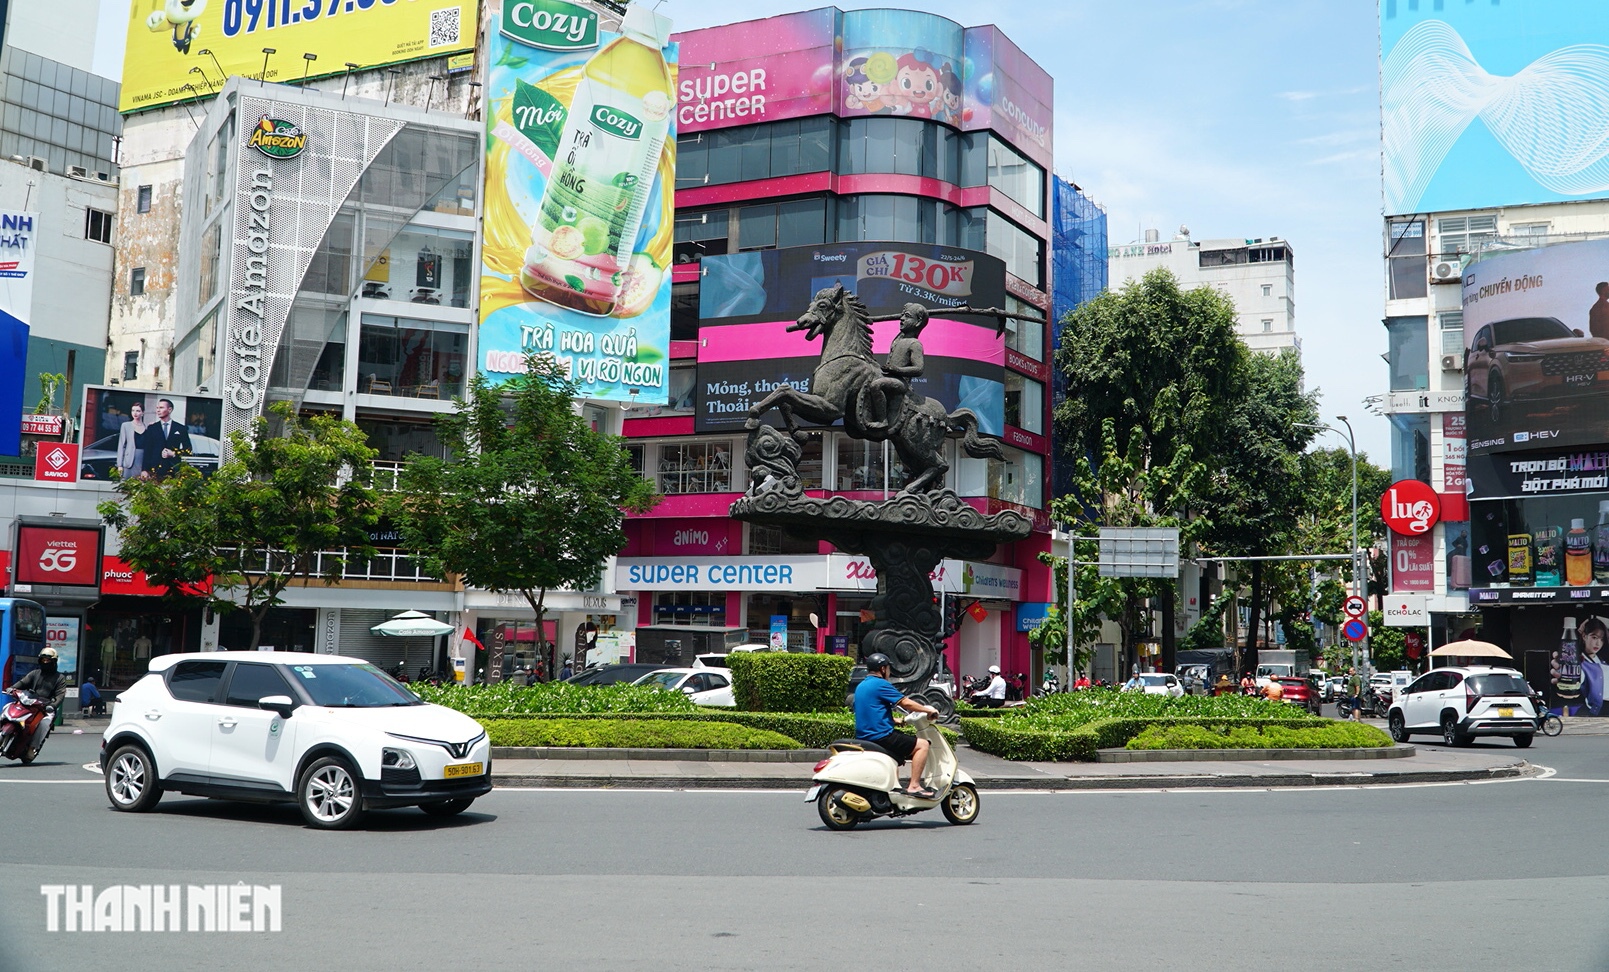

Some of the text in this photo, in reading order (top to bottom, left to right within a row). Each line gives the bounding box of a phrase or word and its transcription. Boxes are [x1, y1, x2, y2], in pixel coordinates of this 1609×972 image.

[512, 2, 588, 42] Cozy
[153, 90, 163, 99] JSC
[515, 104, 564, 130] Mới
[595, 107, 637, 136] Cozy
[575, 129, 593, 148] TRÀ
[559, 168, 586, 193] HỒNG
[0, 214, 32, 232] NH
[237, 168, 272, 319] Amazon
[820, 252, 847, 263] Sweety
[866, 252, 889, 266] GIÁ
[866, 264, 890, 277] CHỈ
[899, 282, 913, 293] Từ
[1479, 277, 1512, 299] CHUYỂN
[1514, 274, 1543, 292] ĐỘNG
[521, 323, 638, 358] TRÀ HOA QUẢ
[579, 357, 596, 384] VỊ
[599, 355, 620, 381] RÕ
[623, 362, 662, 387] NGON
[1566, 373, 1595, 383] HR-V
[707, 380, 752, 397] Mỏng,
[707, 396, 750, 414] Thoải
[1437, 395, 1466, 403] KNOM
[37, 424, 44, 432] 44
[1471, 438, 1505, 450] SENSING
[1510, 452, 1609, 475] TRỌN BỘ MALT
[1446, 476, 1453, 486] 2
[1521, 477, 1551, 493] ĐỘT
[1551, 475, 1581, 490] PHÁ
[1390, 488, 1433, 533] lug
[1535, 529, 1557, 539] MALTO
[1566, 535, 1590, 546] MALTO
[1508, 538, 1528, 547] MALTO
[39, 549, 77, 572] 5G
[104, 570, 133, 580] phuoc
[975, 575, 998, 587] Children's
[583, 596, 607, 608] DEXUS
[1479, 591, 1499, 600] MALTO
[1570, 589, 1591, 598] MALTO
[1387, 608, 1422, 616] ECHOLAC
[325, 611, 335, 656] mazon
[491, 632, 504, 678] DEXUS
[576, 629, 586, 674] DEXUS
[1559, 664, 1581, 675] ALTO
[447, 765, 480, 776] 50H-901.63
